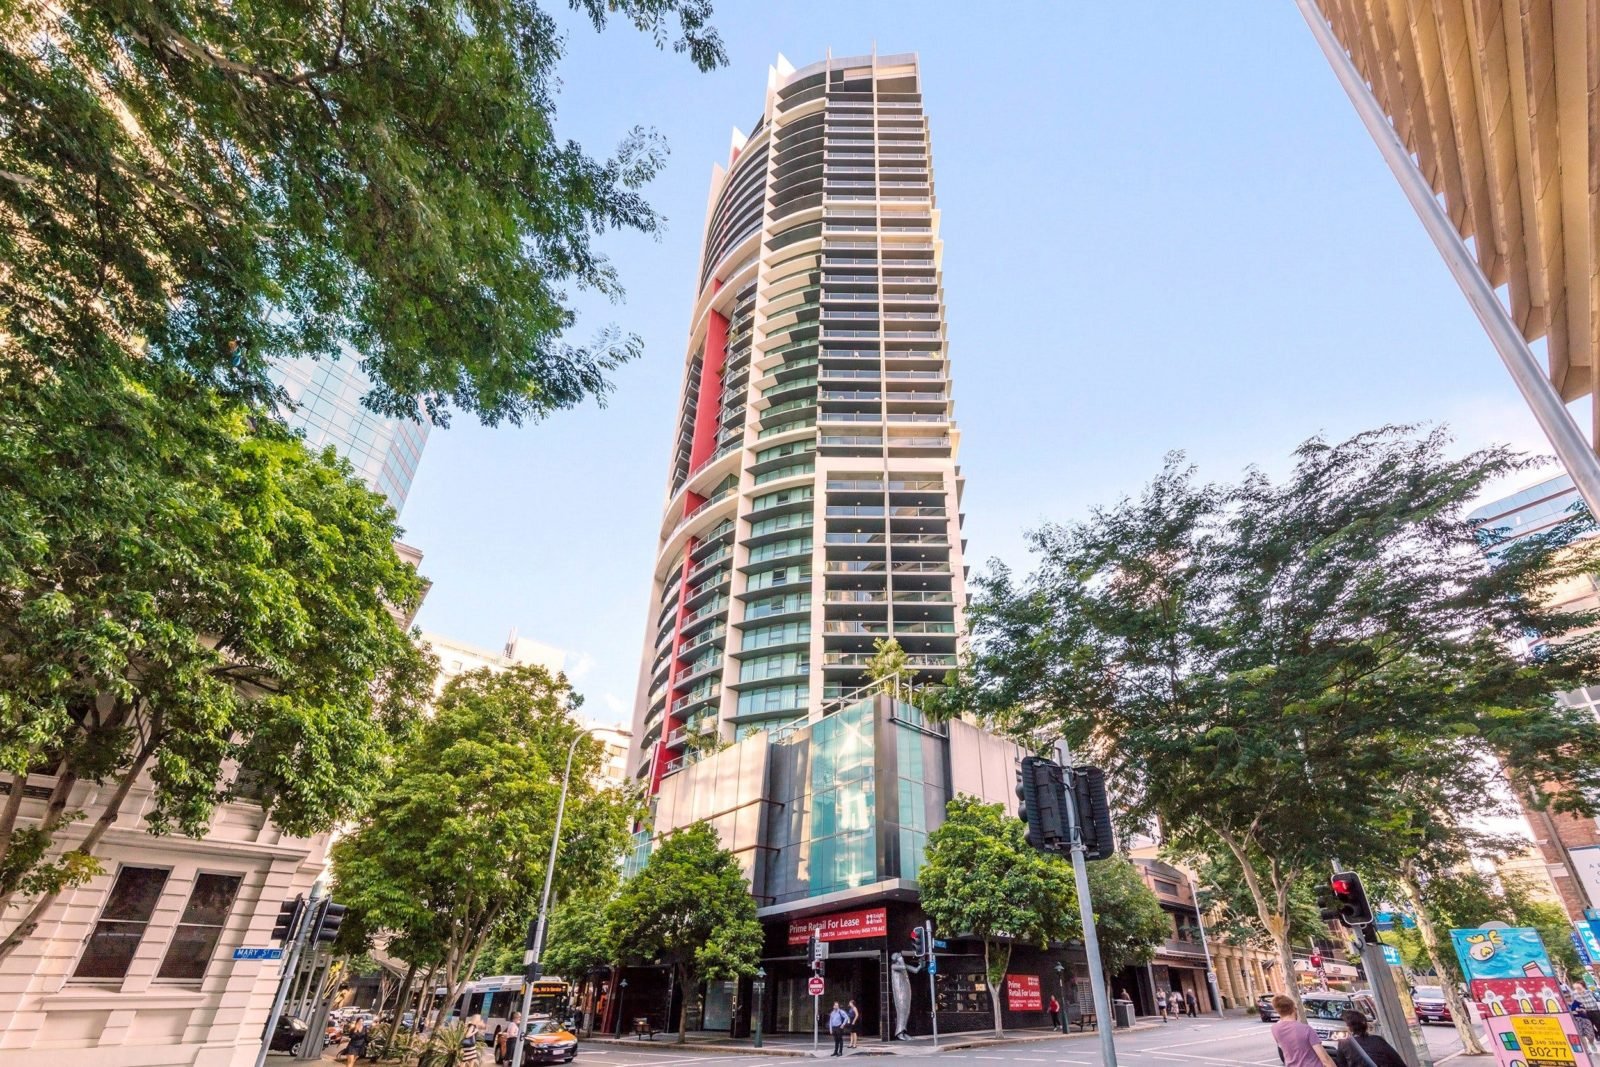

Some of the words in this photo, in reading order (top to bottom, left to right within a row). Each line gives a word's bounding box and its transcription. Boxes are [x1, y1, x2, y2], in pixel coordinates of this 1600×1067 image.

[789, 925, 807, 934] Prime
[808, 920, 827, 931] Retail
[827, 919, 839, 929] For
[840, 918, 860, 928] Lease
[1008, 980, 1021, 989] Prime
[1008, 989, 1022, 997] Retail
[1021, 989, 1029, 997] For
[1028, 989, 1040, 997] Lease
[1528, 1046, 1567, 1058] B0277
